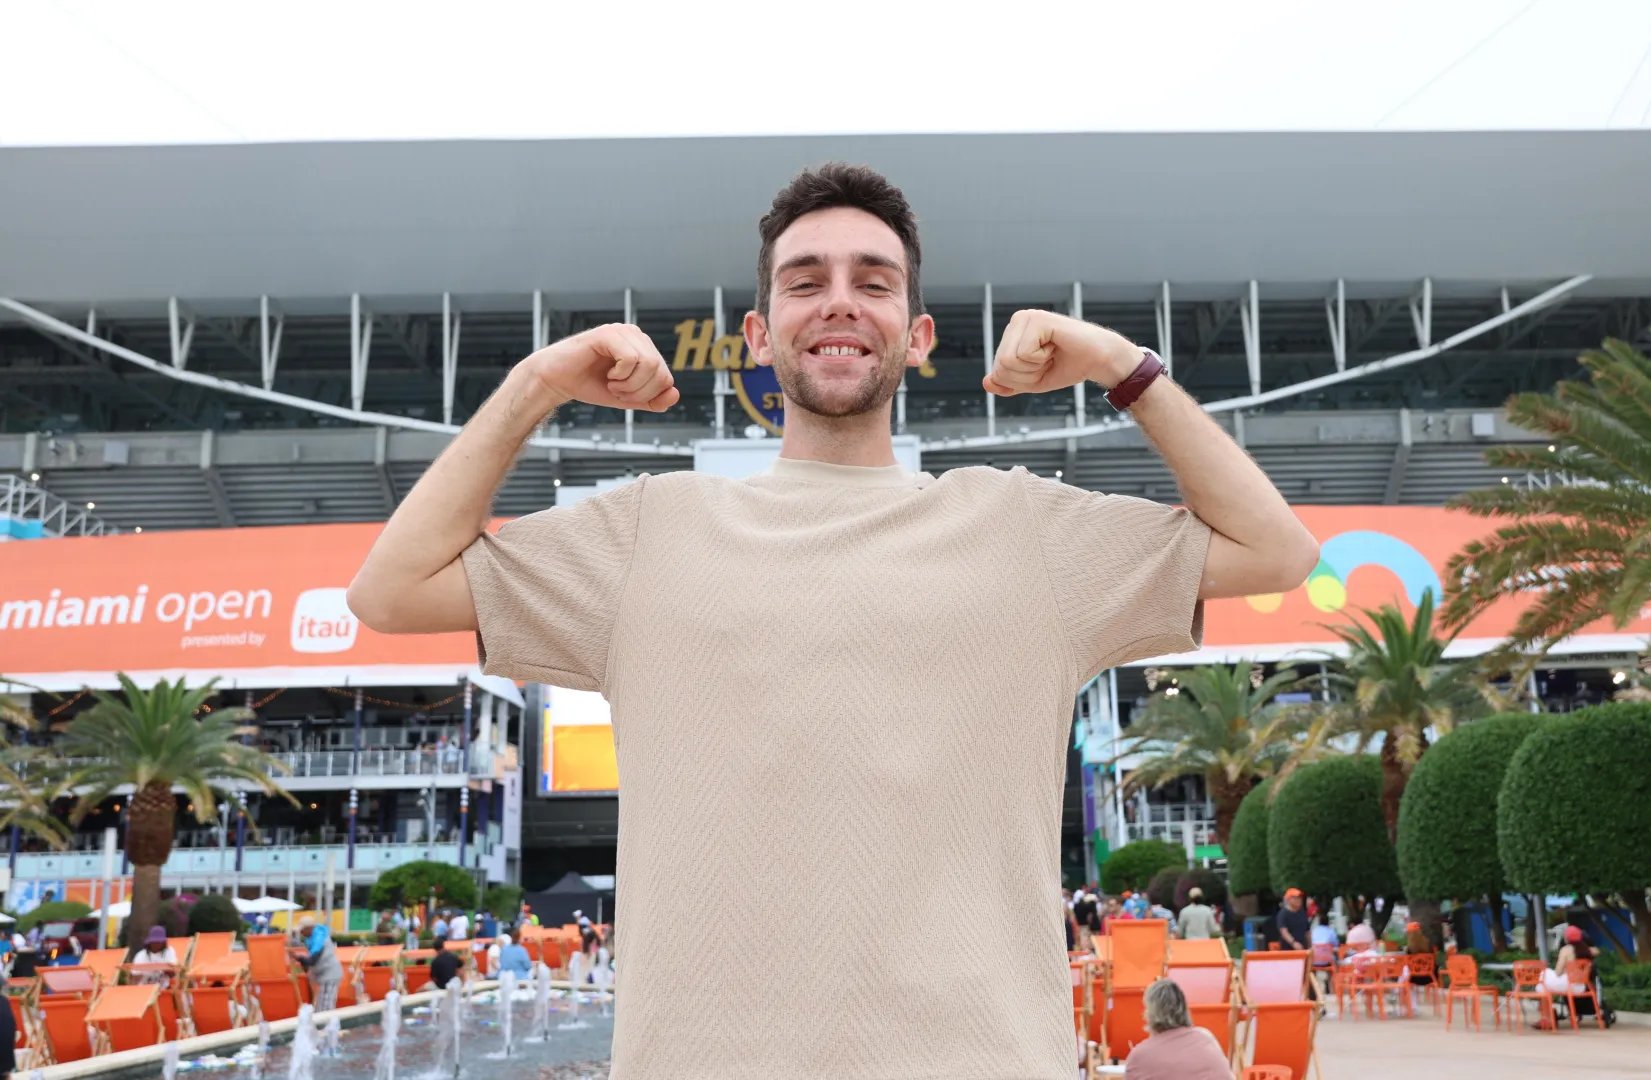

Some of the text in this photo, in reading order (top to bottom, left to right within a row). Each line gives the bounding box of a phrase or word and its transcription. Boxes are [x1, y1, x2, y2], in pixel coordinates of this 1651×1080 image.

[0, 584, 273, 631] miami open
[299, 615, 351, 638] itaú
[181, 629, 266, 649] presented by
